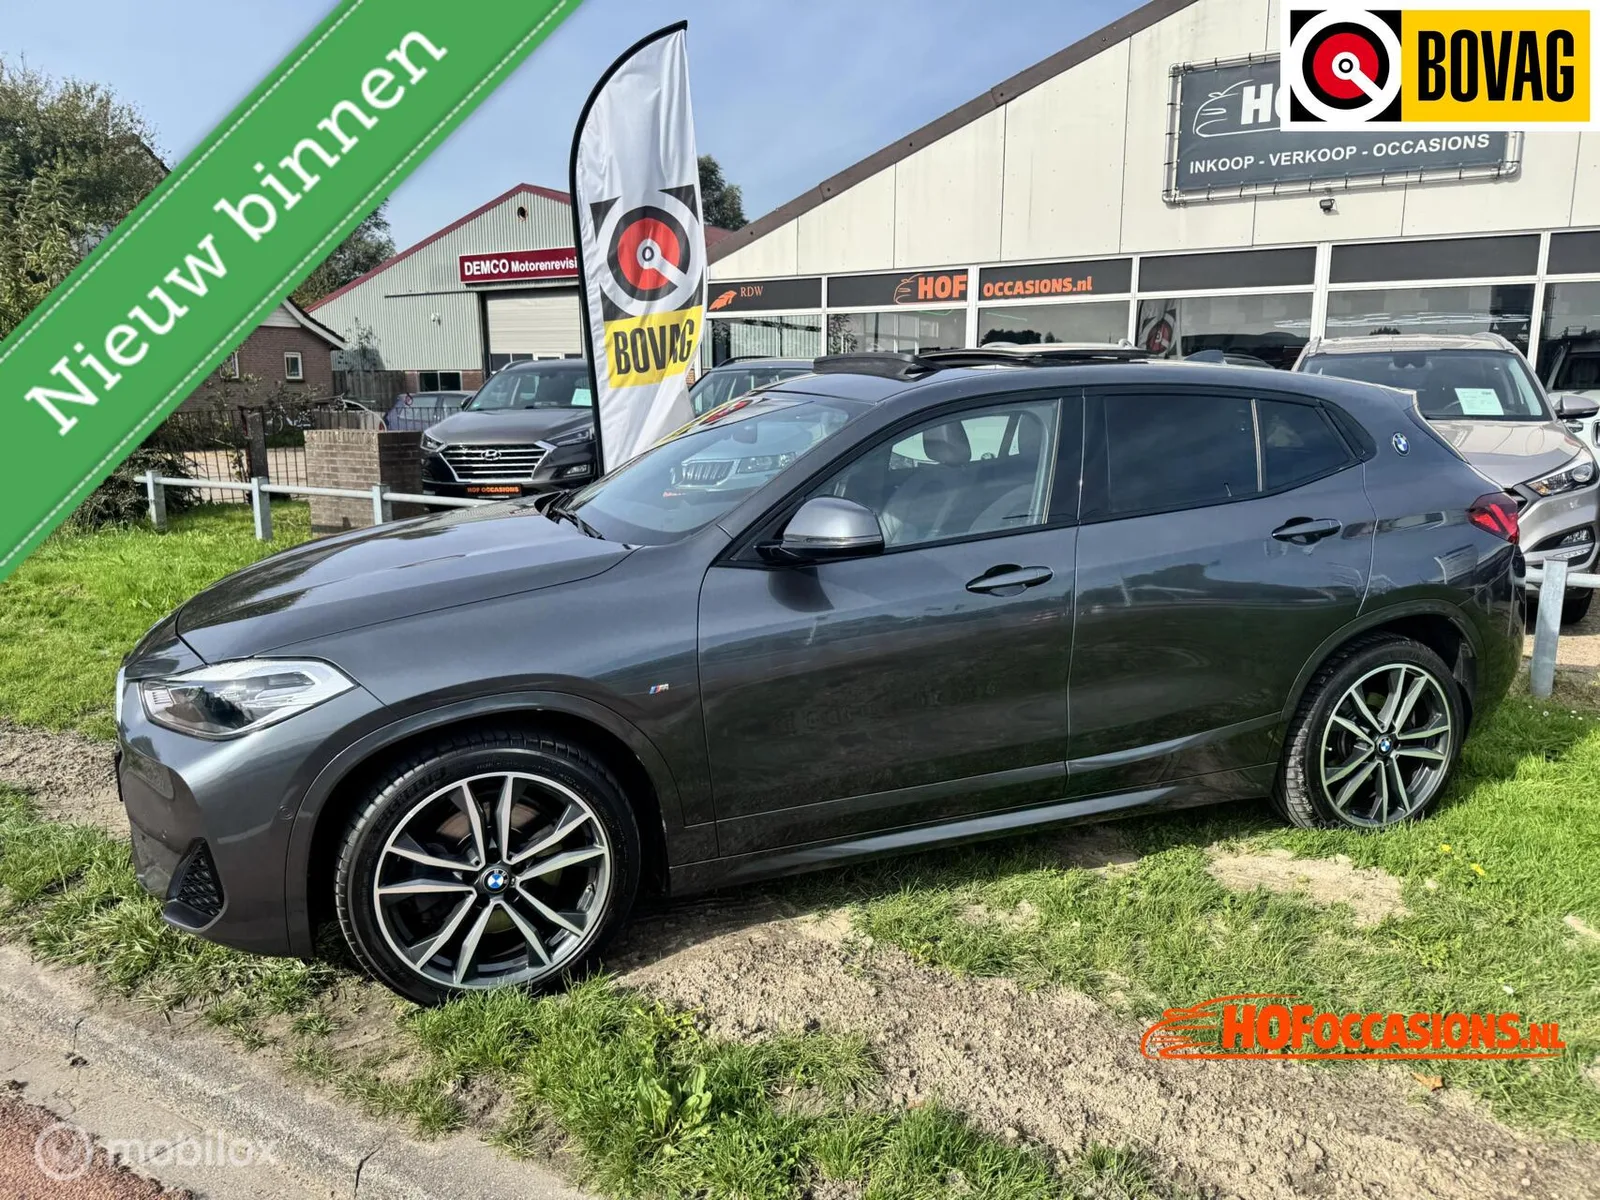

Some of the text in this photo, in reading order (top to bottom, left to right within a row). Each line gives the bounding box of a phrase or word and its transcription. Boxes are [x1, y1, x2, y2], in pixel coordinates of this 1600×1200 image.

[1240, 83, 1280, 125] H
[1189, 155, 1256, 175] INKOOP
[1268, 146, 1358, 167] VERKOOP
[1373, 133, 1490, 158] OCCASIONS
[464, 259, 509, 276] DEMCO
[740, 286, 763, 297] RDW
[917, 275, 1092, 300] HOF OCCASIONS.nl
[613, 319, 694, 375] BOVAG
